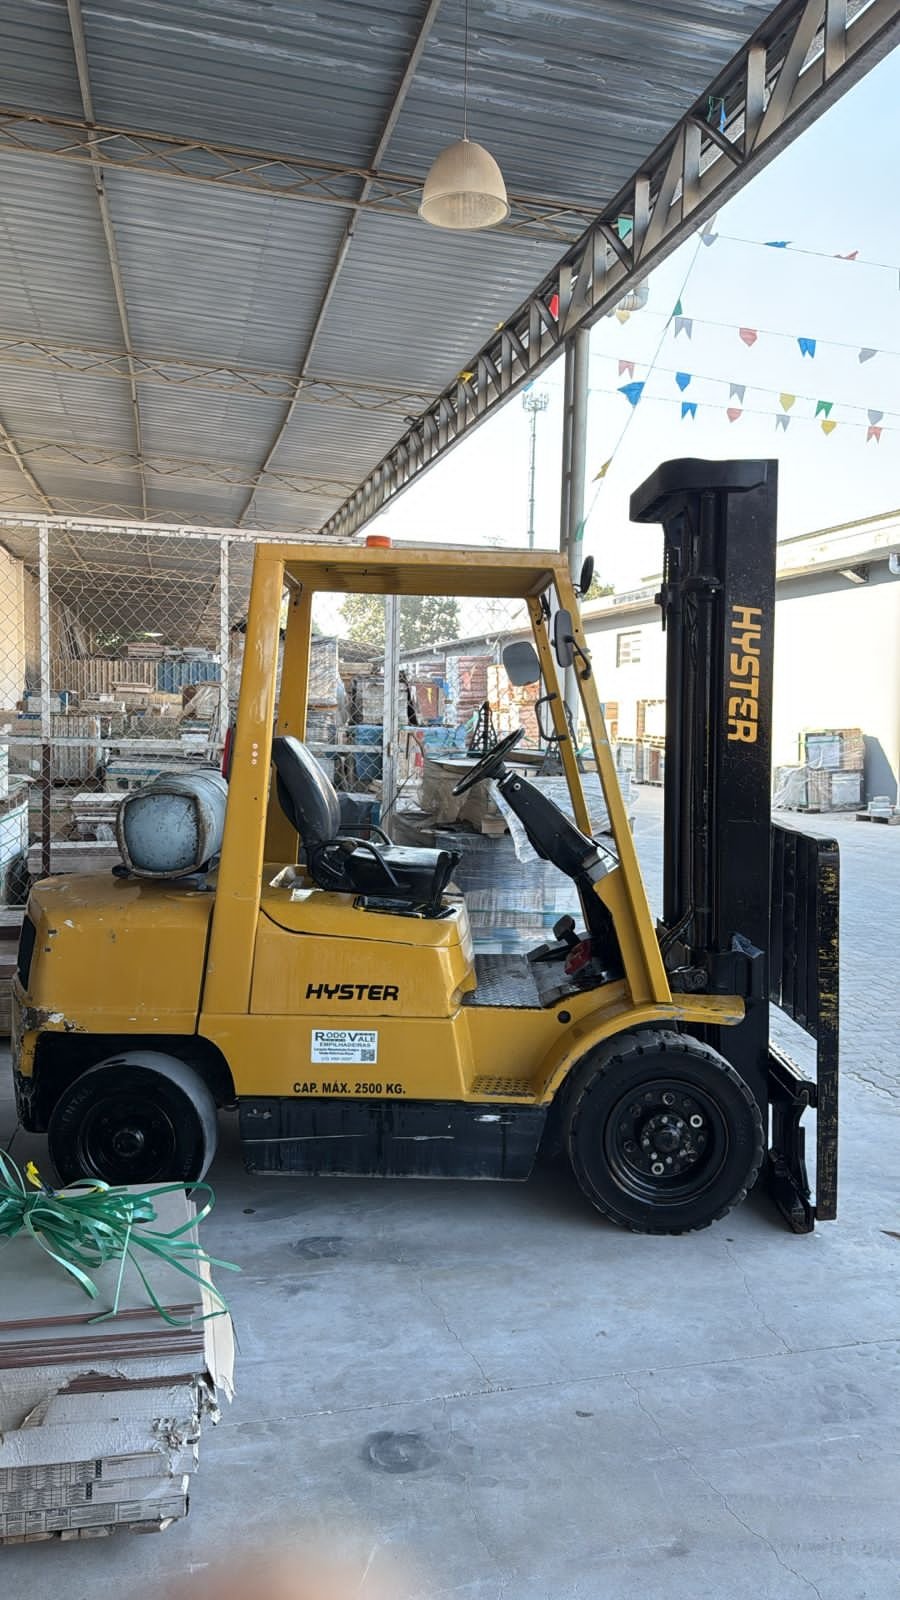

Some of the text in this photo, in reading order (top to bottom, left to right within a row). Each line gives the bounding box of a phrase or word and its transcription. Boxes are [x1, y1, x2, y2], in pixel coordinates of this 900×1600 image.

[727, 605, 762, 743] HYSTER
[305, 984, 399, 1000] HYSTER
[293, 1080, 406, 1094] CAP. MÁX. 2500 KG.
